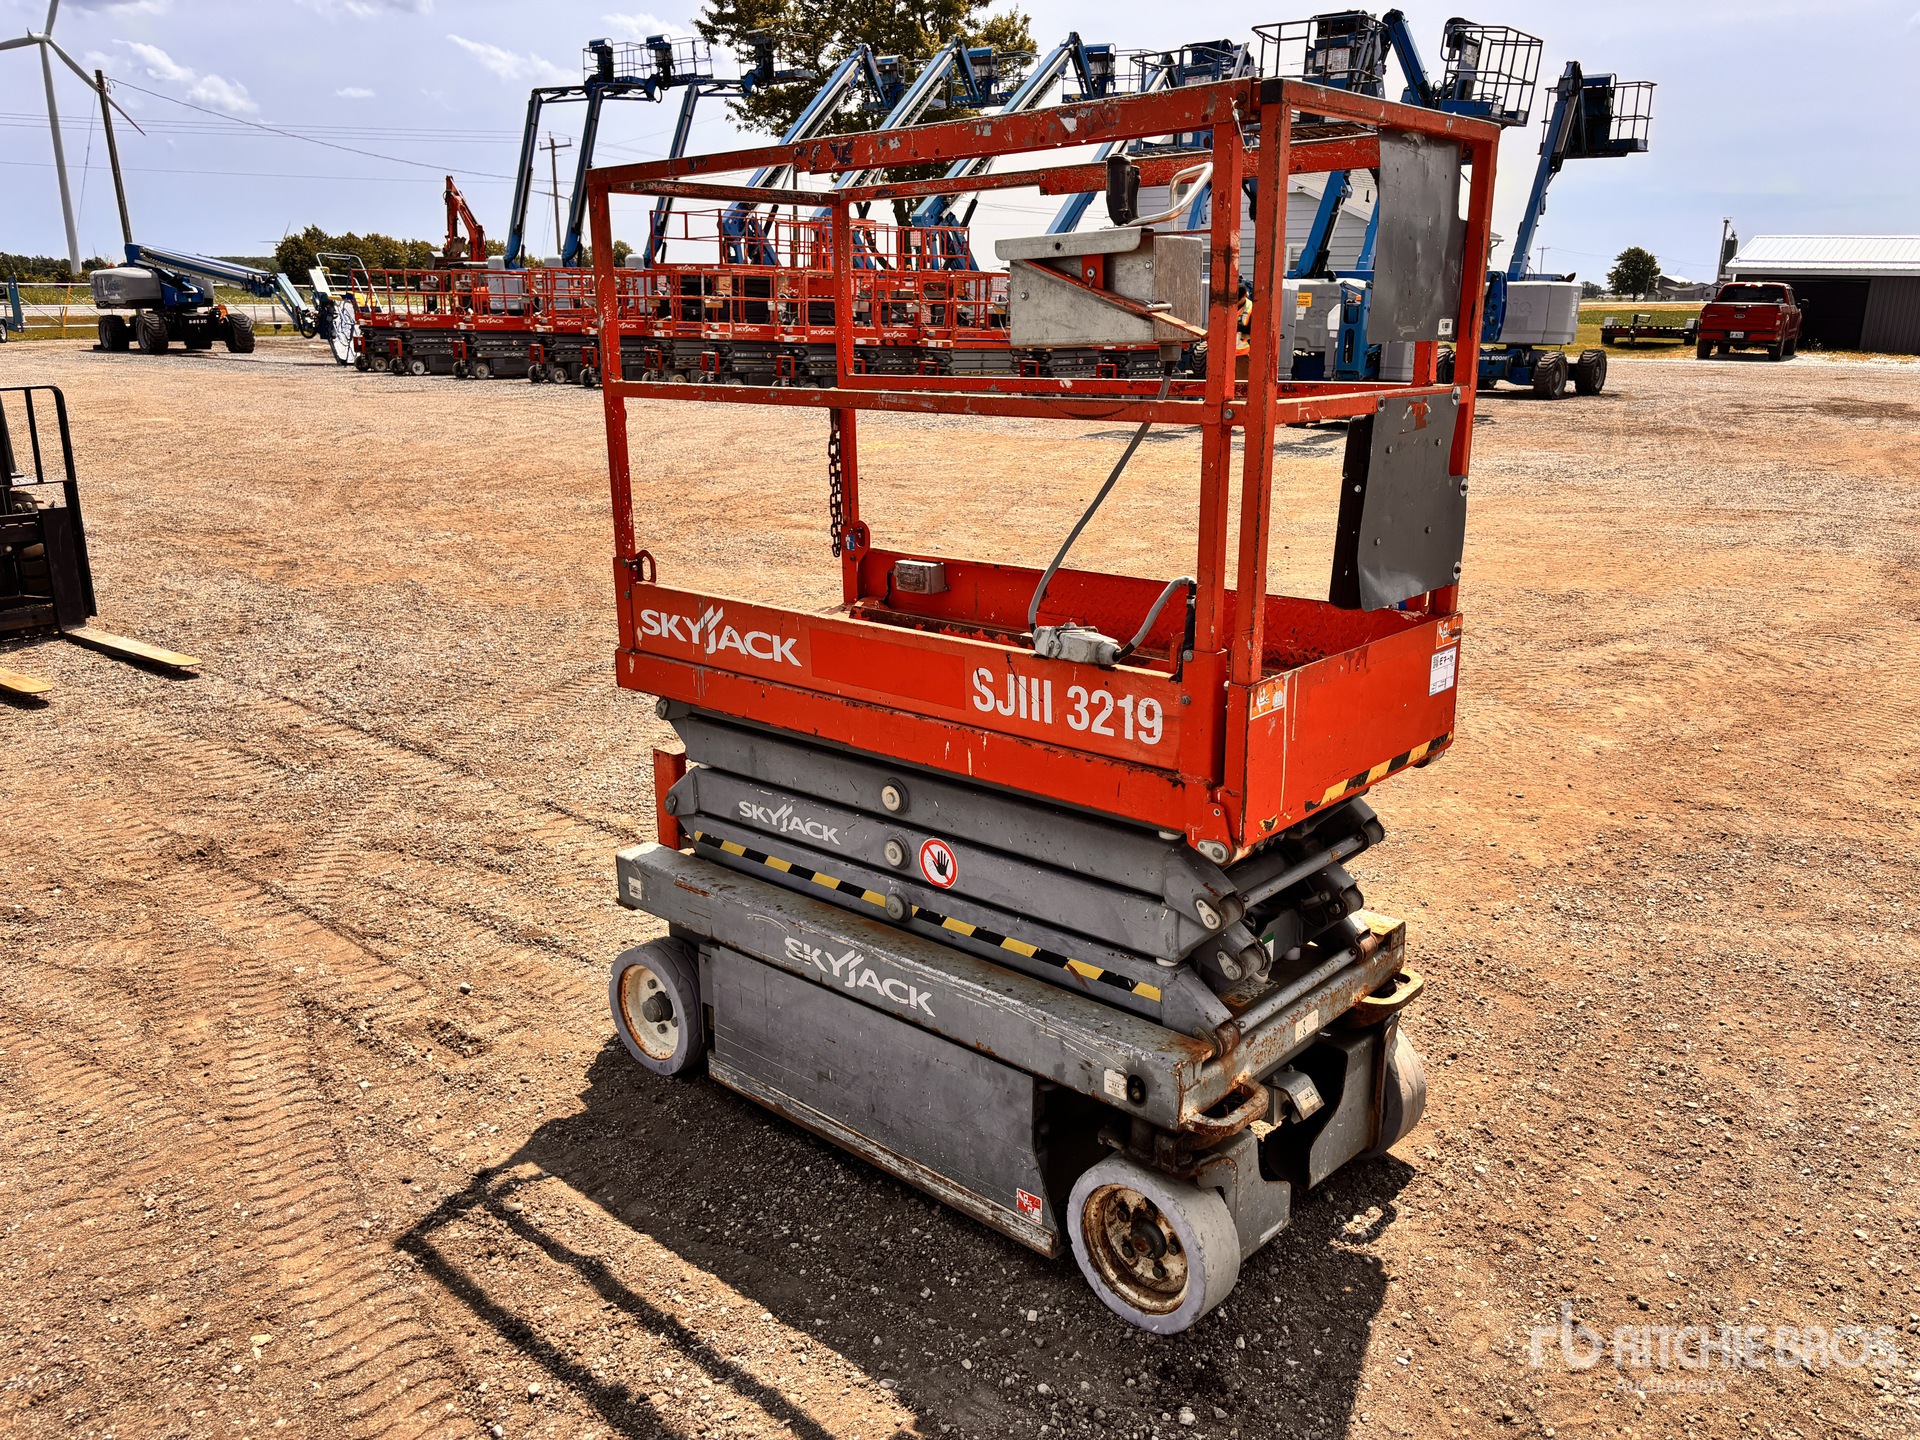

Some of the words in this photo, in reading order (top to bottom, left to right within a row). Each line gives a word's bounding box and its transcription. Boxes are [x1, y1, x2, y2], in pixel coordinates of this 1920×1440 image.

[734, 325, 760, 333] SKYJACK
[810, 328, 835, 336] SKYJACK
[883, 330, 908, 338] SKYJACK
[640, 604, 803, 667] SKYJACK
[972, 667, 1053, 725] SJIII
[1066, 685, 1163, 745] 3219
[738, 800, 841, 846] SKYJACK
[784, 936, 936, 1018] SKYJACK
